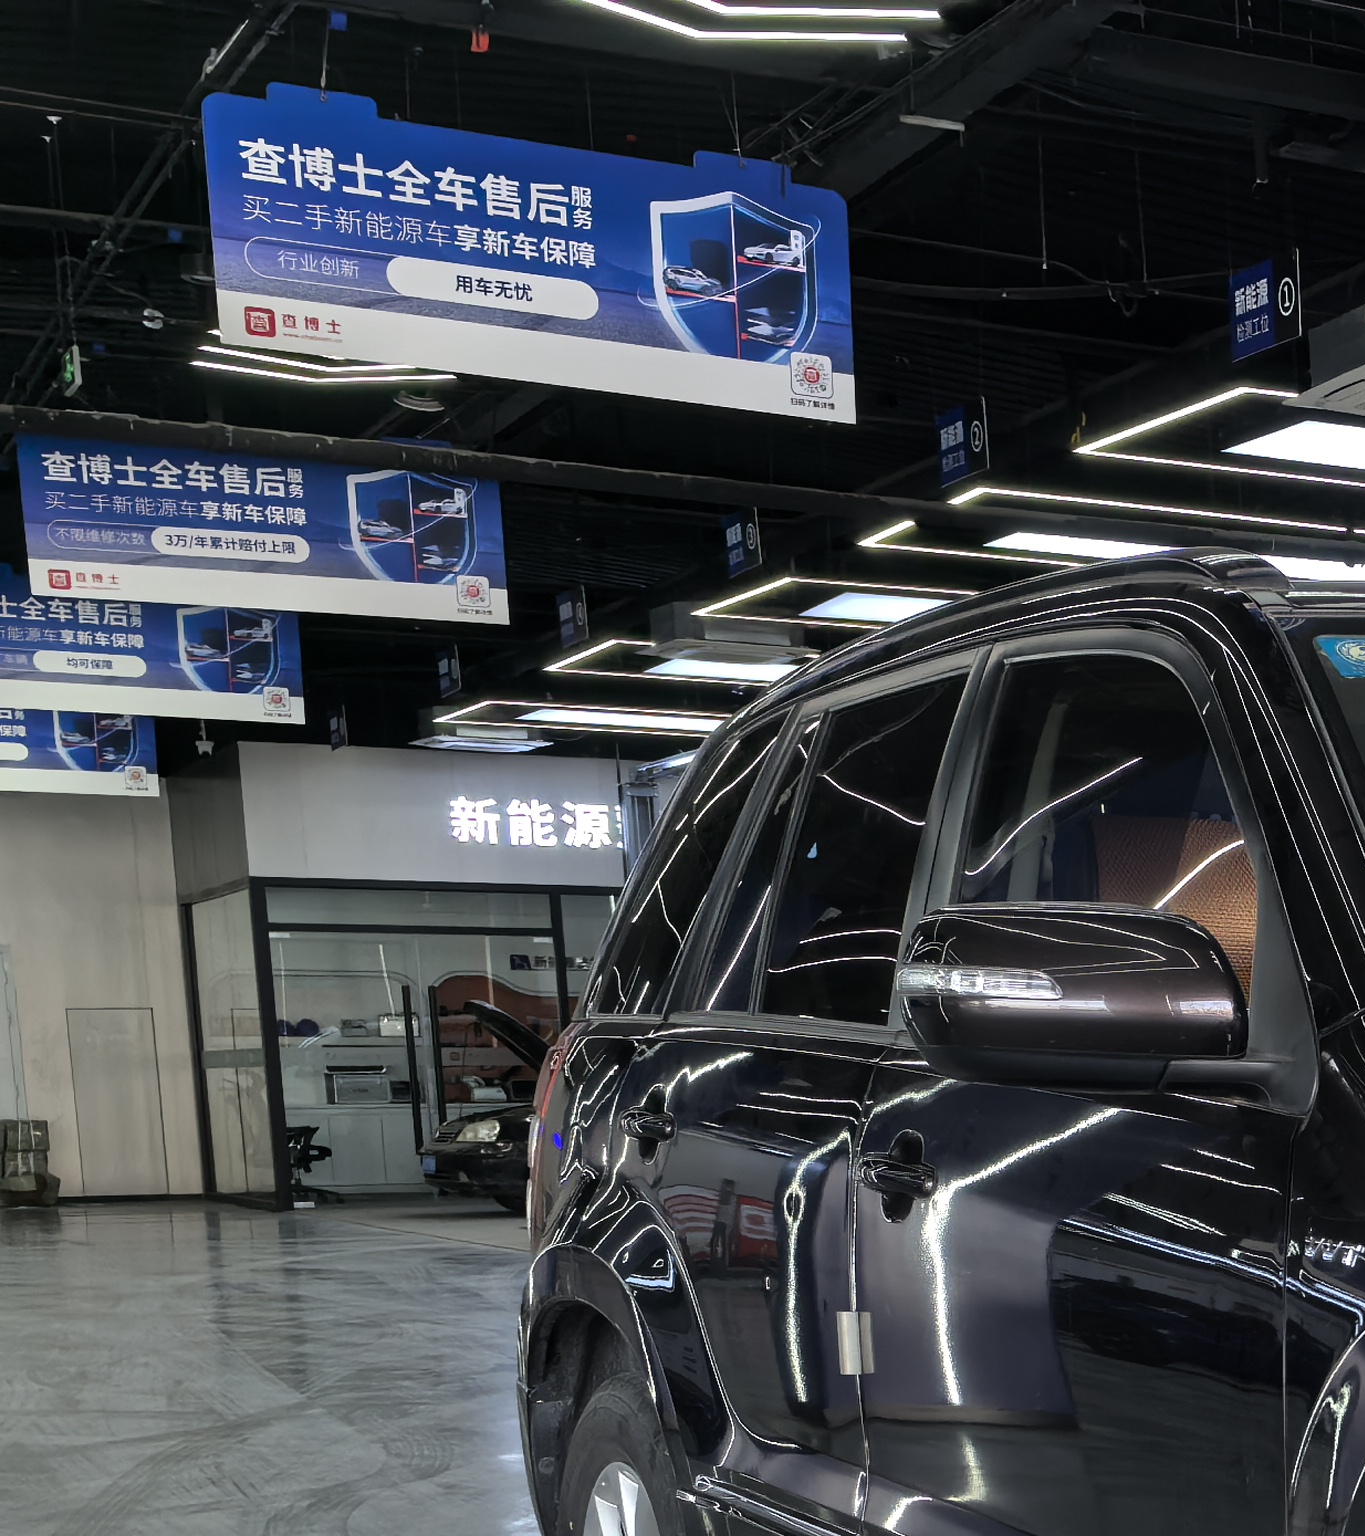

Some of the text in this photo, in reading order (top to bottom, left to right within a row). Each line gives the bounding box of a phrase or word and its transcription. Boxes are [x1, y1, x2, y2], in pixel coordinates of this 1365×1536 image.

[239, 138, 570, 227] 查博士全车售后
[571, 185, 593, 230] 服务
[243, 194, 597, 269] 买二手新能源车享新车保障
[277, 250, 533, 302] 行业创新 用车无忧
[1234, 277, 1269, 317] 新能源
[281, 313, 342, 335] 查博士
[41, 450, 287, 499] 查博士全车售后
[44, 491, 308, 527] 买二手新能源车享新车保障
[54, 527, 297, 555] 不限维修次数 3万/年累计赔付上限
[450, 795, 624, 850] 新能源
